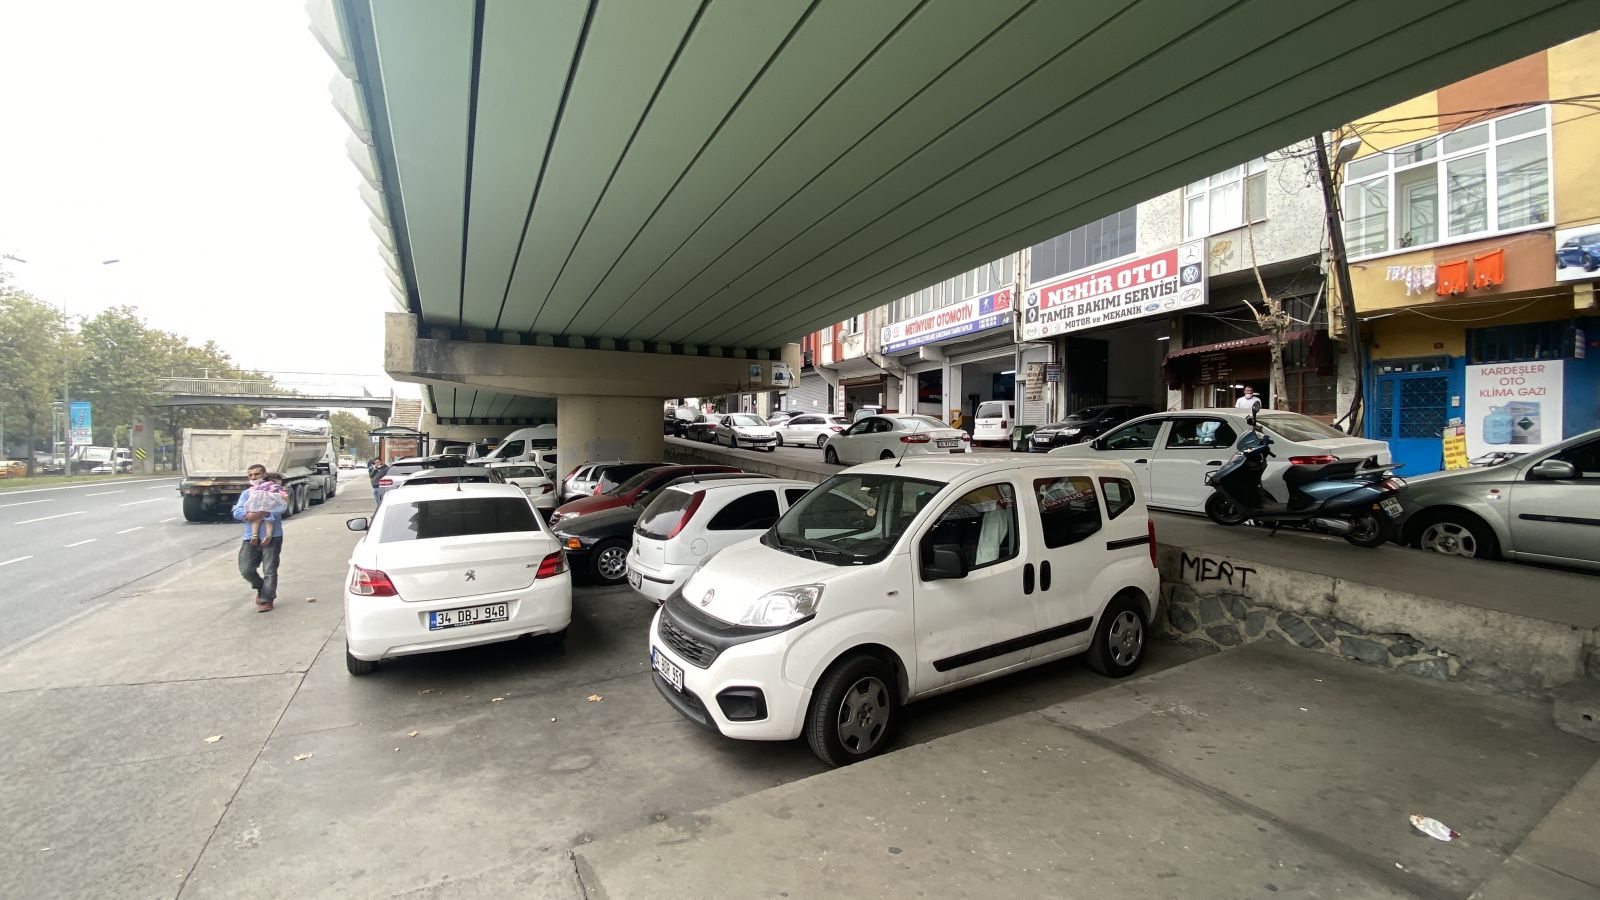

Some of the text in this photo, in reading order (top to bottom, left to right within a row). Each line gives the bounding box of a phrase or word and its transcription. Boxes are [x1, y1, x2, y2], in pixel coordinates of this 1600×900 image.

[1047, 259, 1167, 308] NEHİR OTO
[1040, 276, 1178, 324] TAMİR BAKIMI SERVİSİ
[936, 303, 973, 327] OTOMOTİV
[1064, 314, 1090, 329] MOTOR
[1102, 304, 1142, 322] MEKANİK
[1481, 365, 1545, 376] KARDEŞLER
[1499, 377, 1525, 386] OTO
[1479, 387, 1546, 398] KLİMA GAZI
[1180, 552, 1257, 588] MERT
[437, 613, 452, 625] 34
[458, 609, 479, 622] DBJ
[484, 605, 505, 619] 948
